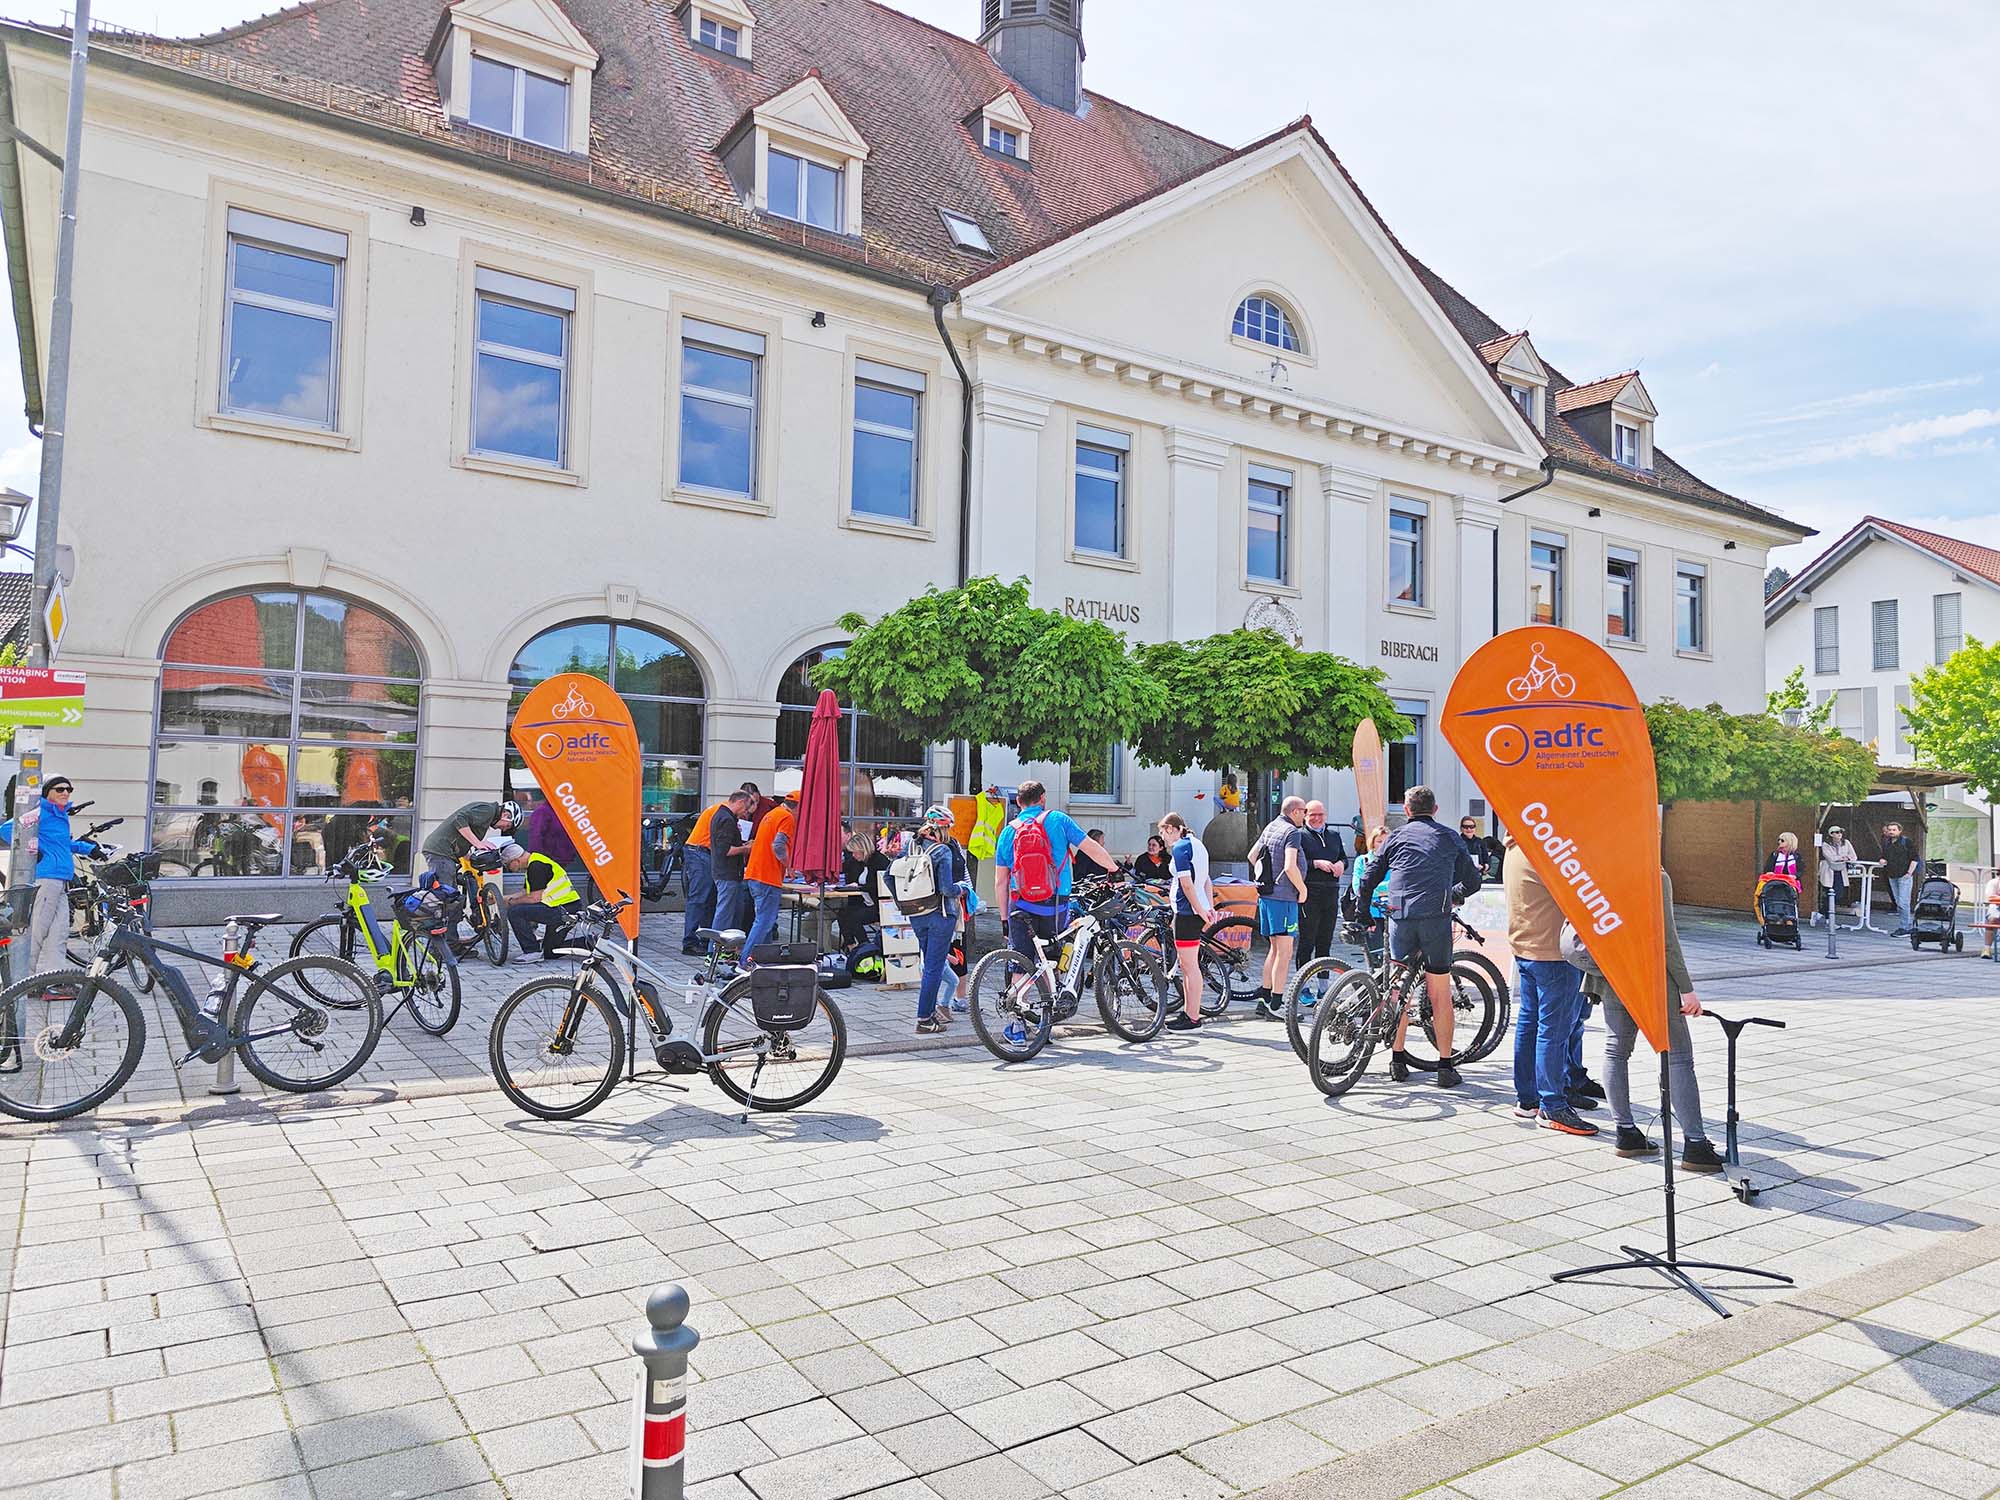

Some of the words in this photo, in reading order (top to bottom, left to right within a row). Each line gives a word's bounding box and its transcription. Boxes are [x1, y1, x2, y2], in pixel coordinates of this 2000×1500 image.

[1065, 596, 1140, 624] RATHAUS
[1381, 639, 1438, 662] BIBERACH
[566, 732, 610, 748] adfc
[1534, 722, 1604, 748] adfc
[1536, 751, 1580, 760] Allgemeiner
[1581, 750, 1619, 759] Deutscher
[1536, 760, 1585, 769] Fahrrad-Club
[554, 781, 614, 867] Codierung
[1520, 801, 1623, 936] Codierung
